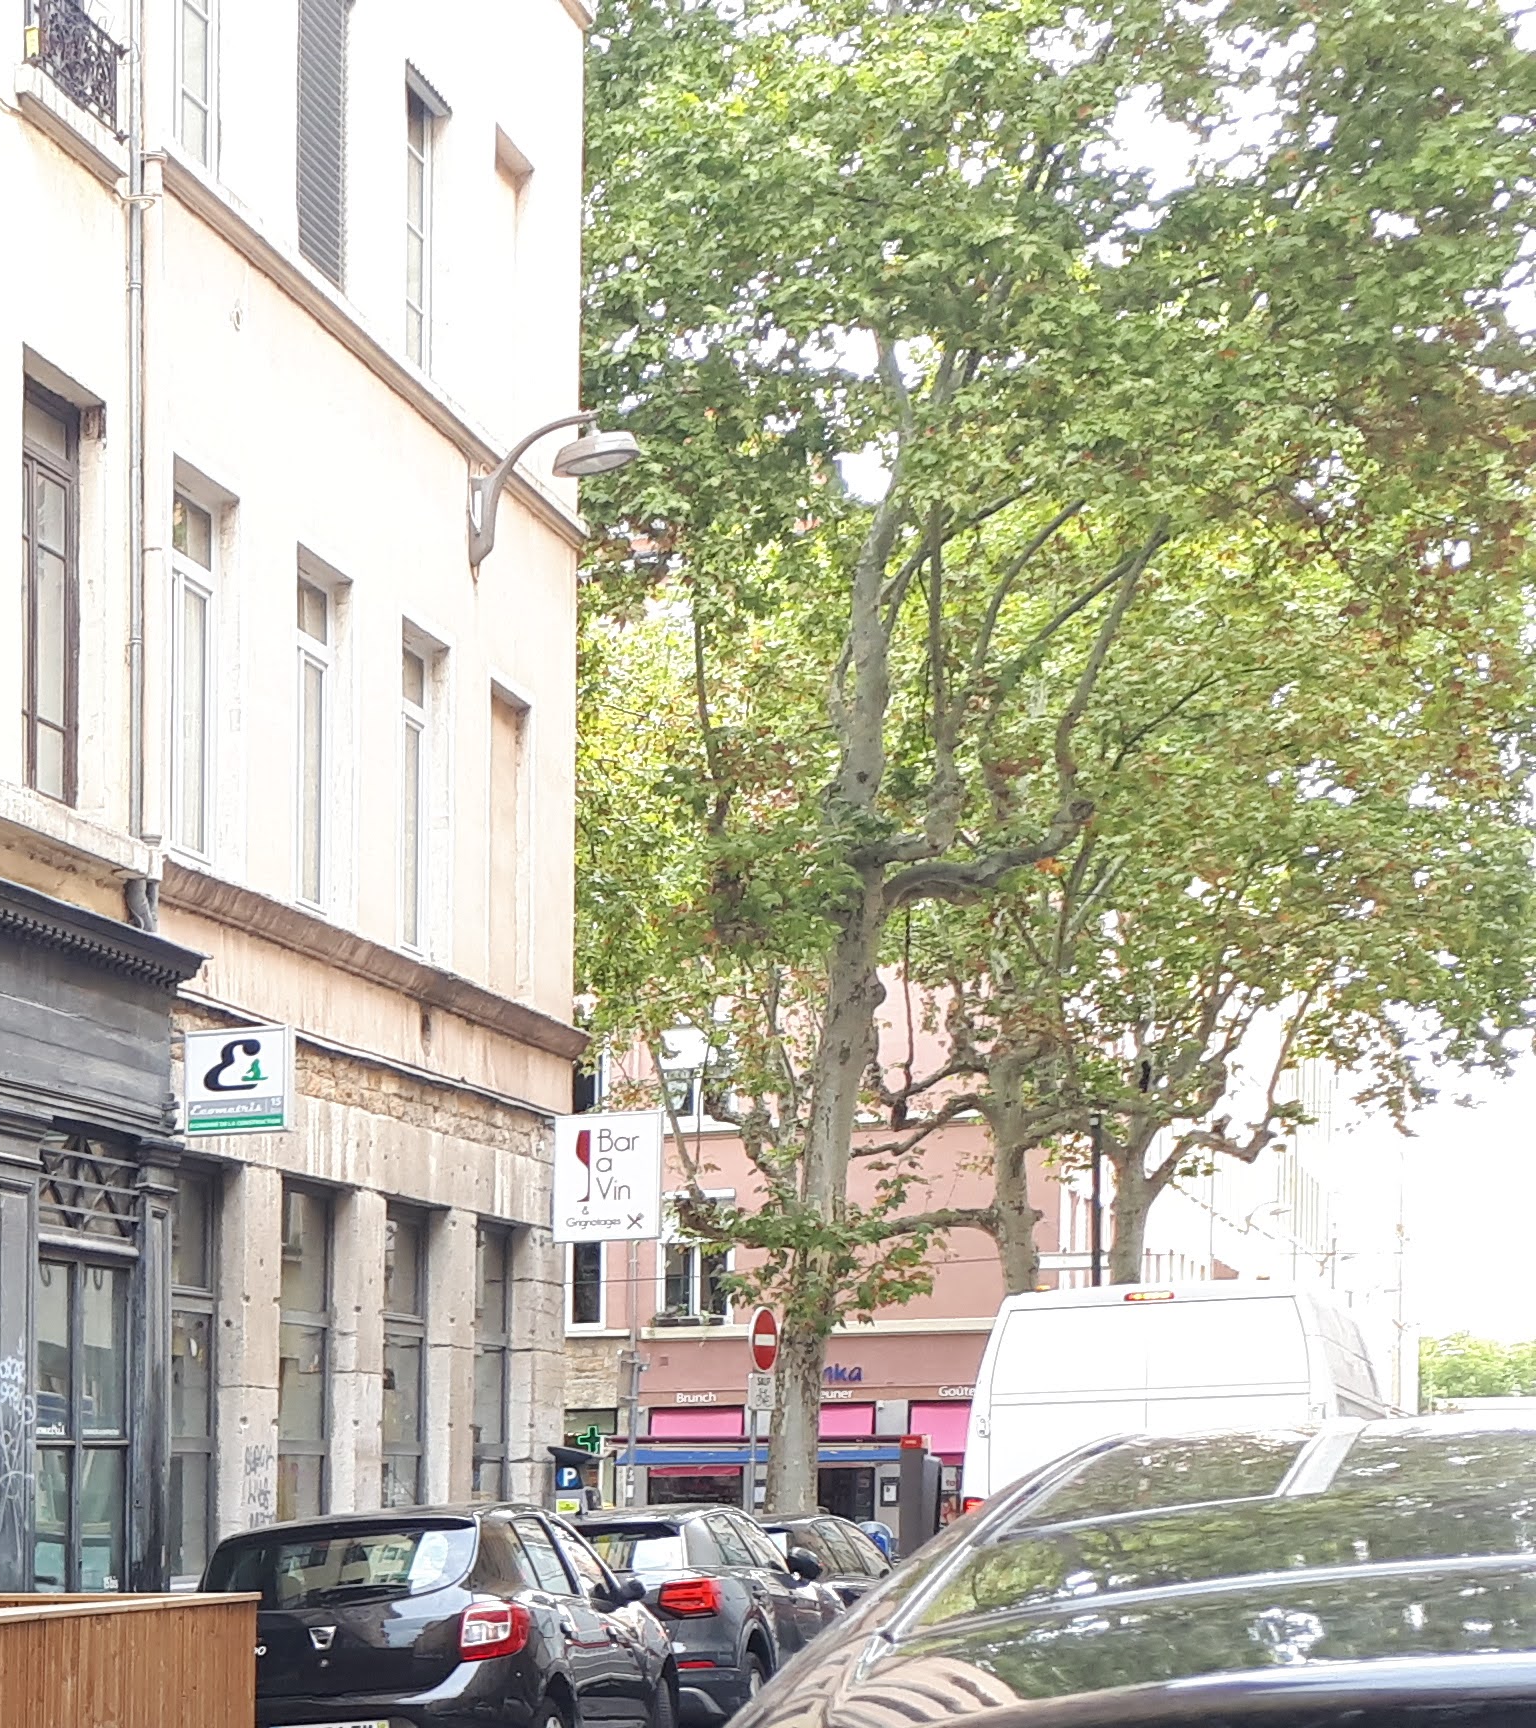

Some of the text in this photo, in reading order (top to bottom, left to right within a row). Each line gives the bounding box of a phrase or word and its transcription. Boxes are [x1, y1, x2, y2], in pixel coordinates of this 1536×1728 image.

[190, 1102, 263, 1116] Ecometris
[597, 1128, 640, 1153] Bar
[596, 1157, 613, 1172] a
[596, 1176, 631, 1200] Vin
[566, 1217, 621, 1230] Grignotages
[676, 1391, 717, 1405] Brunch
[821, 1390, 853, 1399] euner
[938, 1385, 976, 1397] Goûte
[562, 1467, 577, 1487] P
